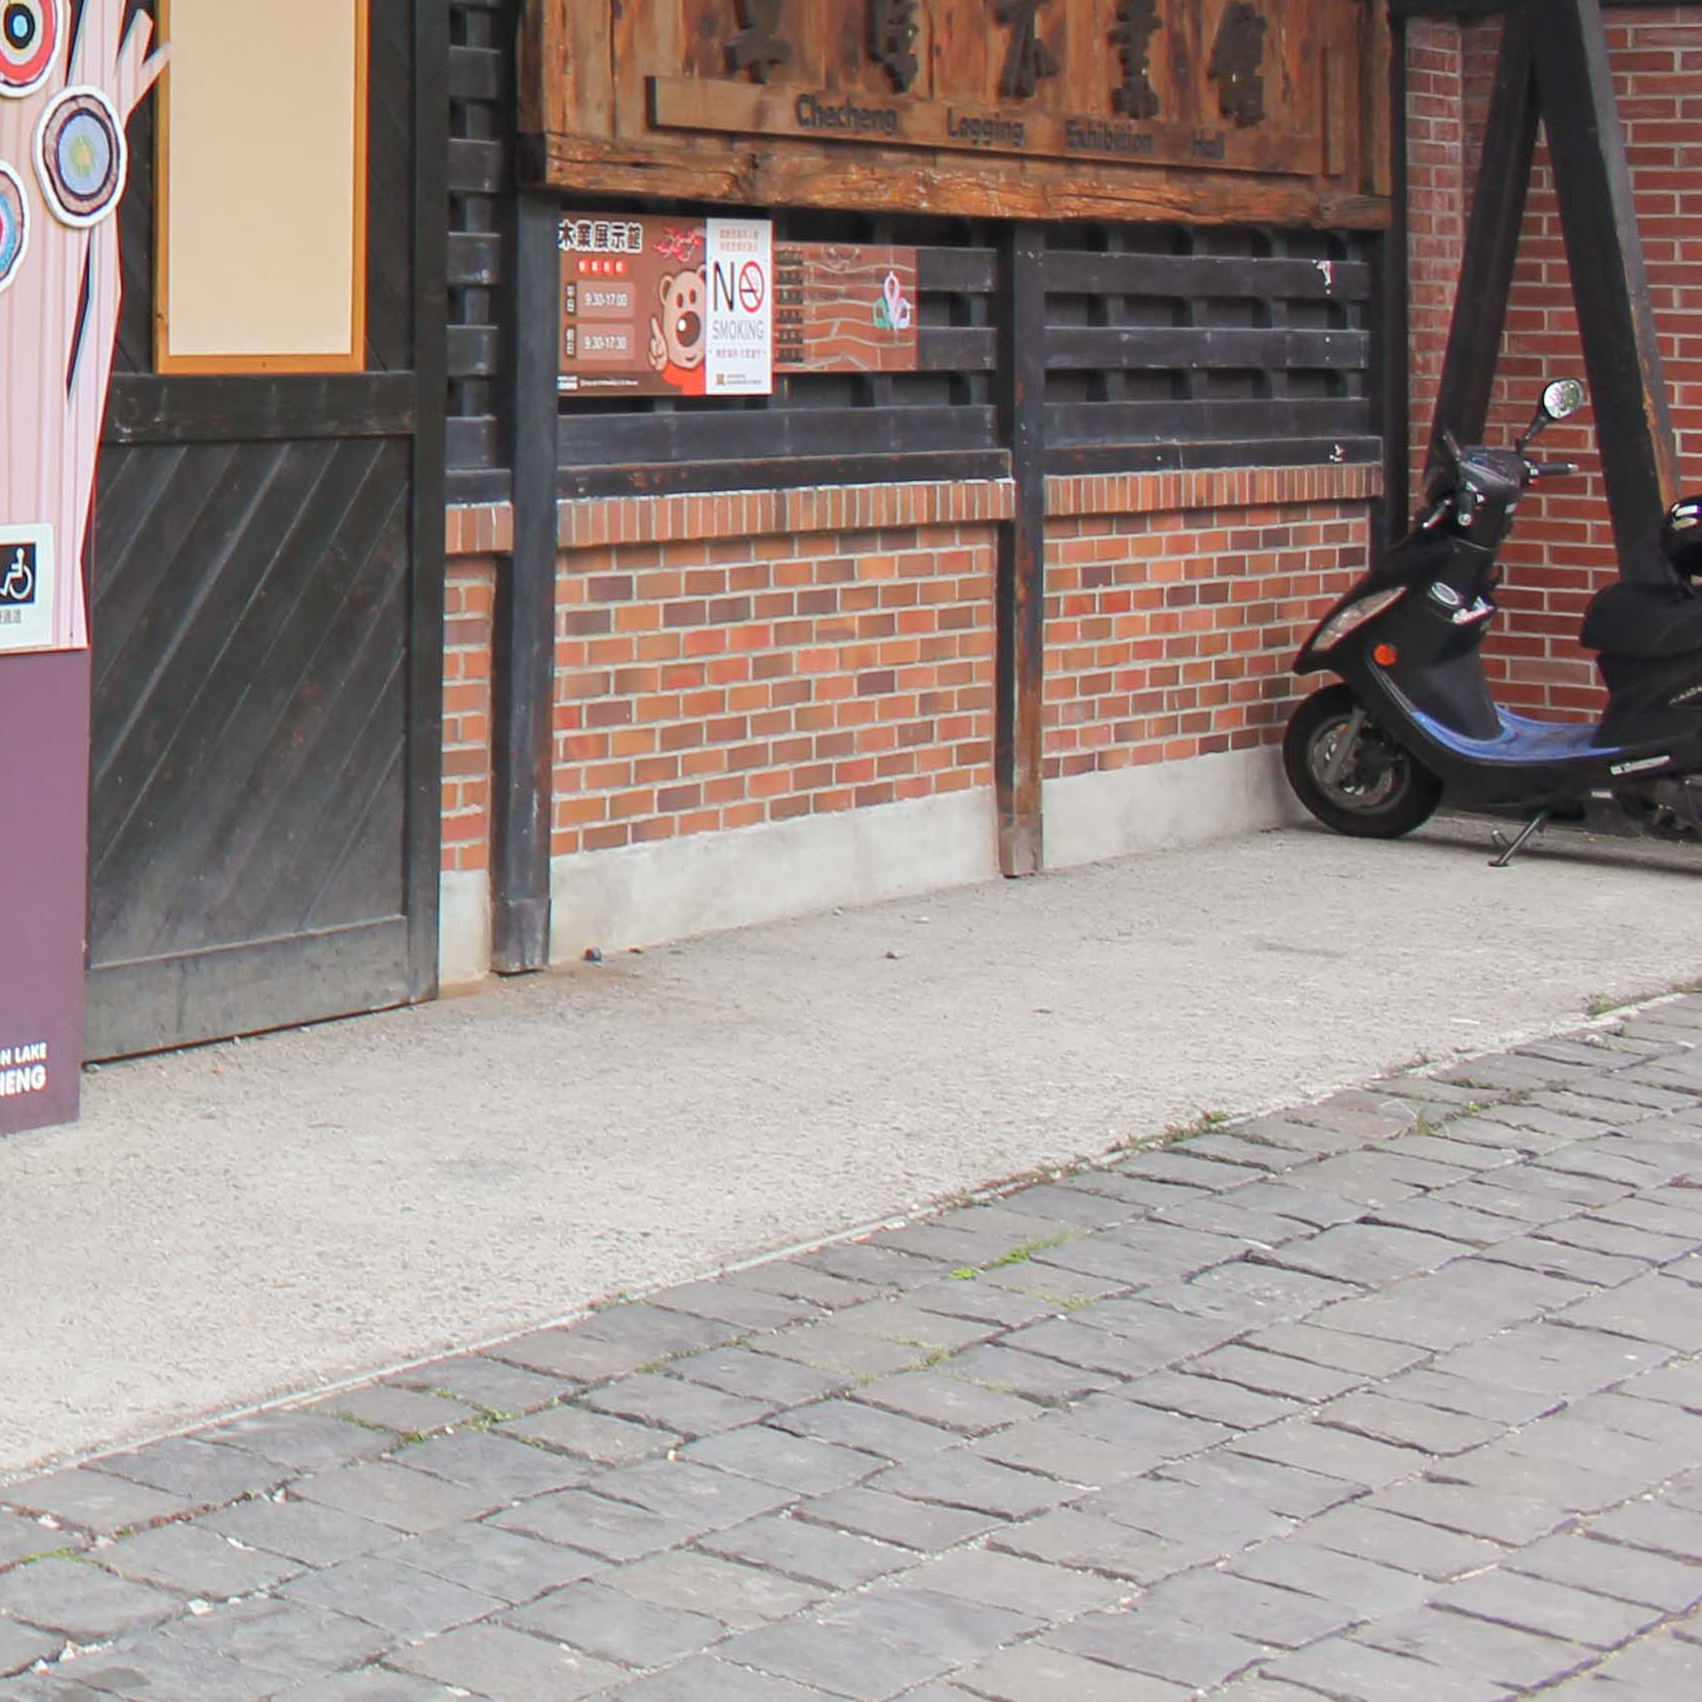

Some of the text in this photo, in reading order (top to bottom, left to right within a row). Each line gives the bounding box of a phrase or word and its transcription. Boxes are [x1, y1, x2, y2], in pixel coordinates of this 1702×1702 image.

[796, 94, 896, 136] Checheng
[947, 108, 1025, 148] Logging
[1066, 120, 1154, 154] Exhibition
[712, 319, 765, 341] SMOKING
[15, 1041, 47, 1064] LAKE
